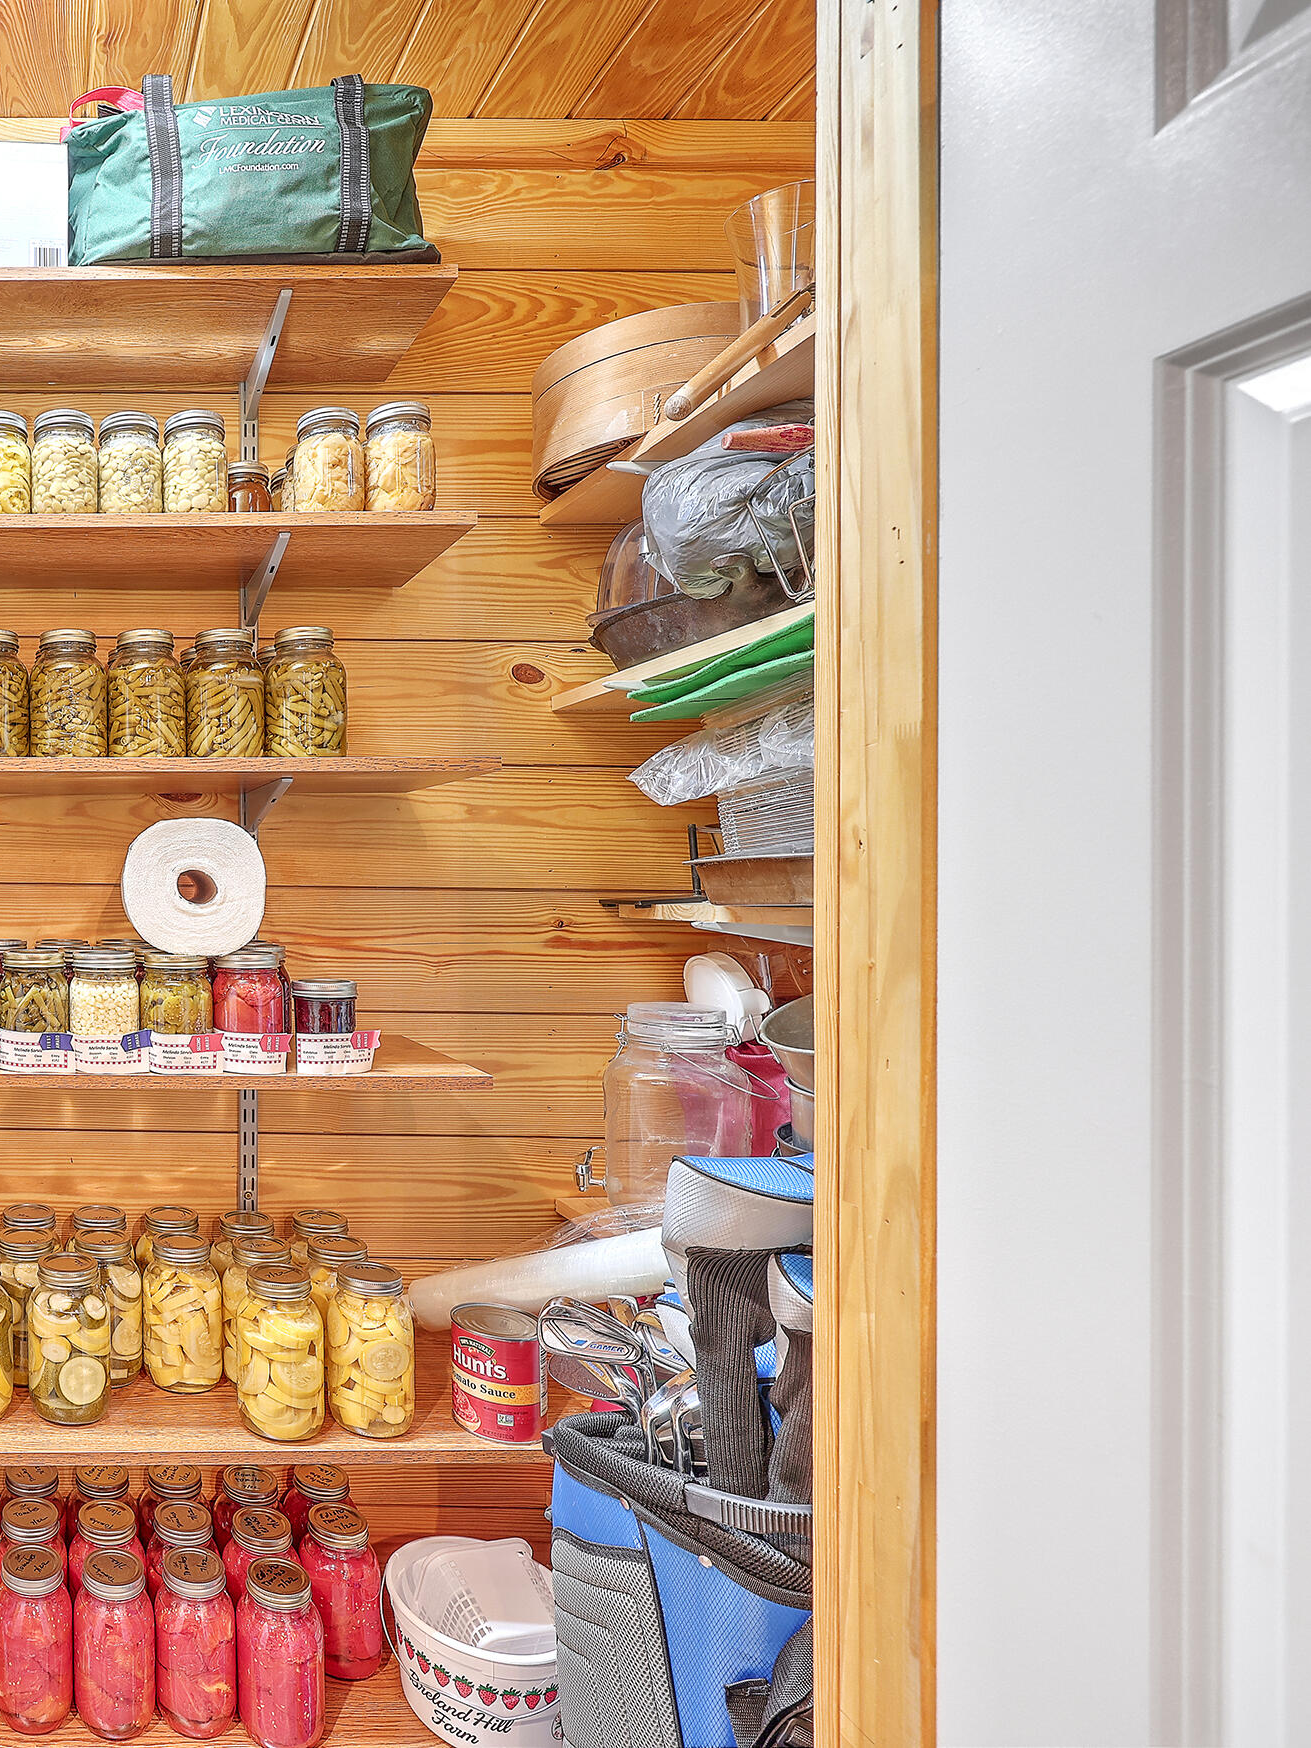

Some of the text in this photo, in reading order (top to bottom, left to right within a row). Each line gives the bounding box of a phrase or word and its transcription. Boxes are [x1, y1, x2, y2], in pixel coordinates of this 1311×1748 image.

[220, 115, 274, 126] MEDICAL
[191, 128, 326, 169] Foundation
[218, 162, 299, 175] LMCFoundation.com
[589, 1342, 625, 1354] GAMER
[453, 1343, 508, 1380] Hunt's
[479, 1382, 516, 1399] Sauce
[409, 1668, 515, 1734] Breland Hill
[431, 1709, 480, 1745] Farm
